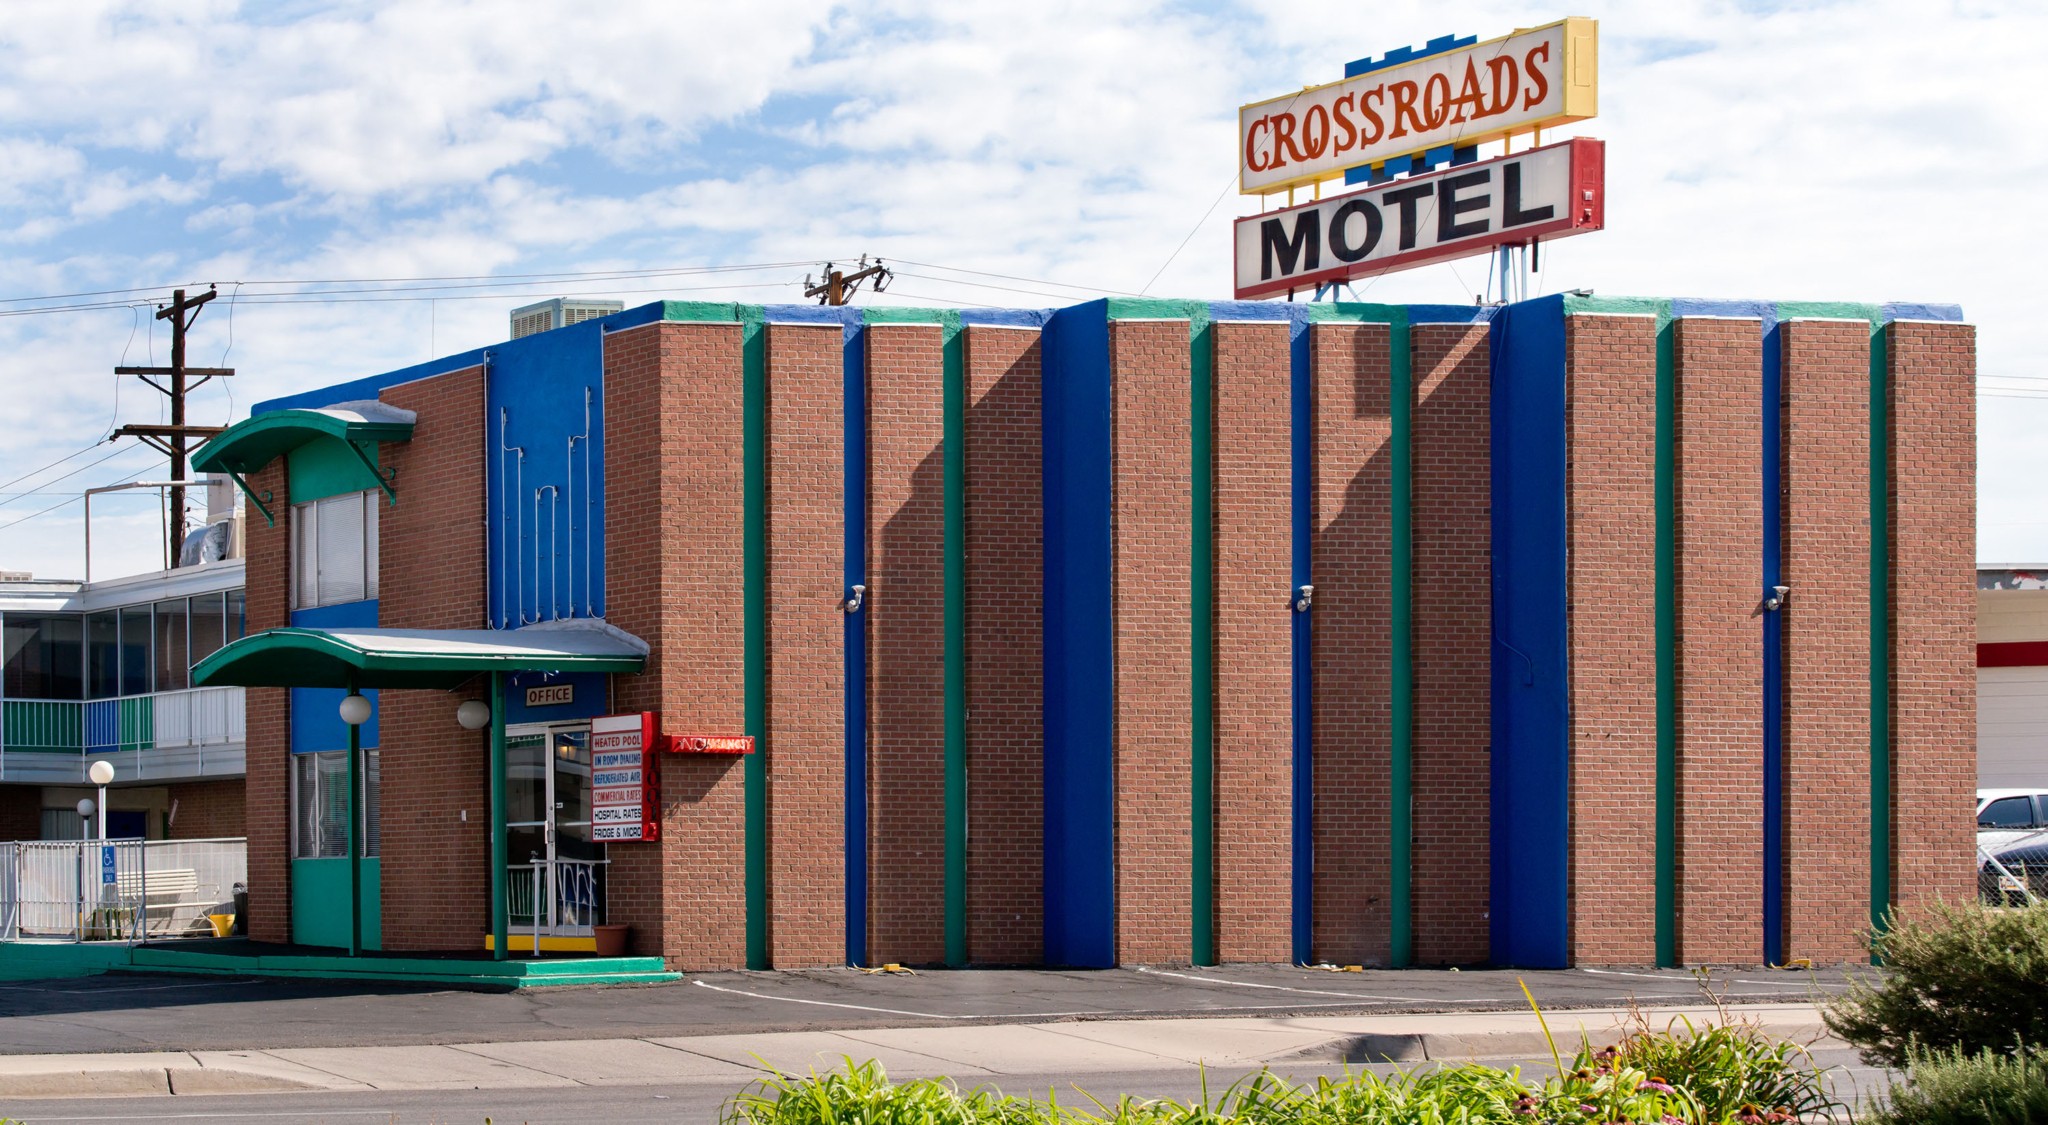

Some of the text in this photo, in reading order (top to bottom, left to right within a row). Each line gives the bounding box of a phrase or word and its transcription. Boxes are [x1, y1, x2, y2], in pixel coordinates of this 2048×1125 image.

[1246, 41, 1549, 172] CROSSROADS
[1260, 161, 1554, 281] MOTEL
[529, 688, 570, 702] OFFICE
[594, 734, 641, 748] HEATED POOL
[680, 738, 706, 751] NO
[594, 753, 641, 766] IN ROOM DIALING
[594, 771, 641, 785] REFRIGERATED AIR
[594, 789, 641, 803] COMMERCIAL RATES
[594, 808, 642, 820] HOSPITAL RATES
[594, 828, 614, 838] FRIDGE
[622, 826, 642, 837] MICRO
